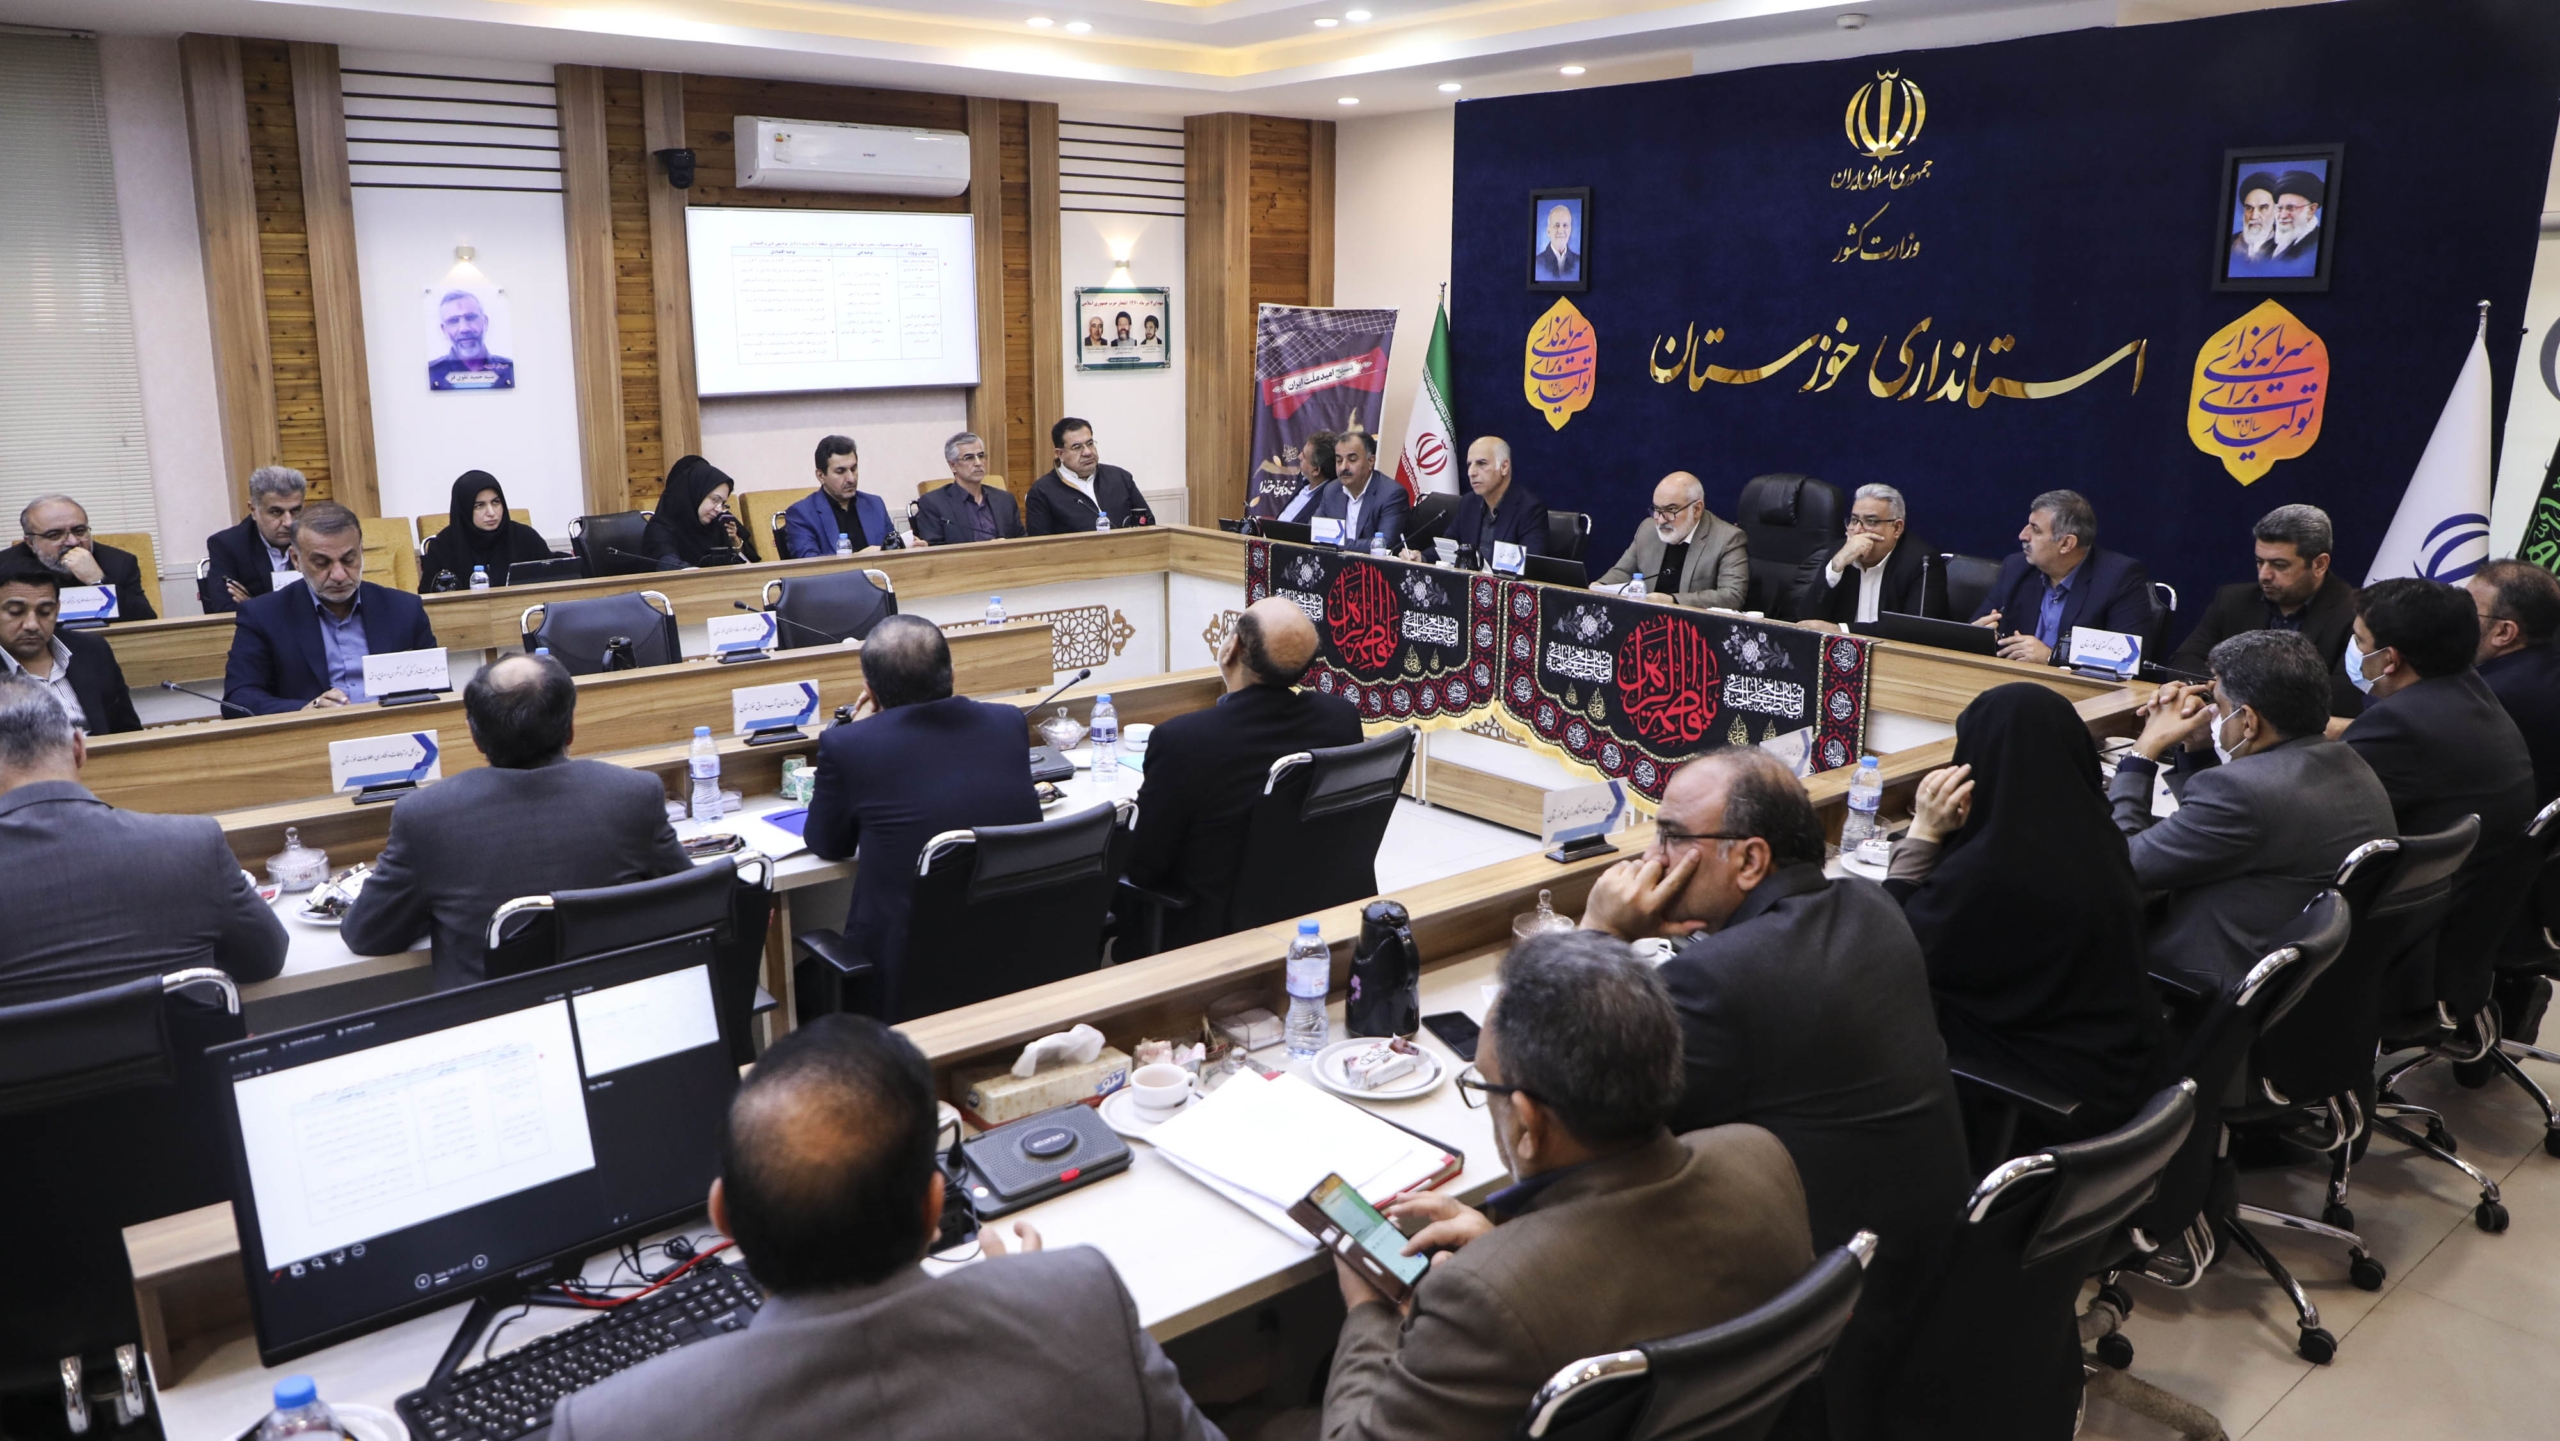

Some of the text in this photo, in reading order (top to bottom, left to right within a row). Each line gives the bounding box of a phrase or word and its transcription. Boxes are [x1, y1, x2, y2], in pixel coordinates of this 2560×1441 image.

[1830, 159, 1933, 190] جمهوری اسلامی ایران
[1831, 201, 1920, 263] وزارت کشور
[1335, 364, 1354, 379] بسیج
[1649, 316, 2148, 409] استانداری خوزستان
[1288, 379, 1303, 391] ایران
[1320, 368, 1334, 381] امید
